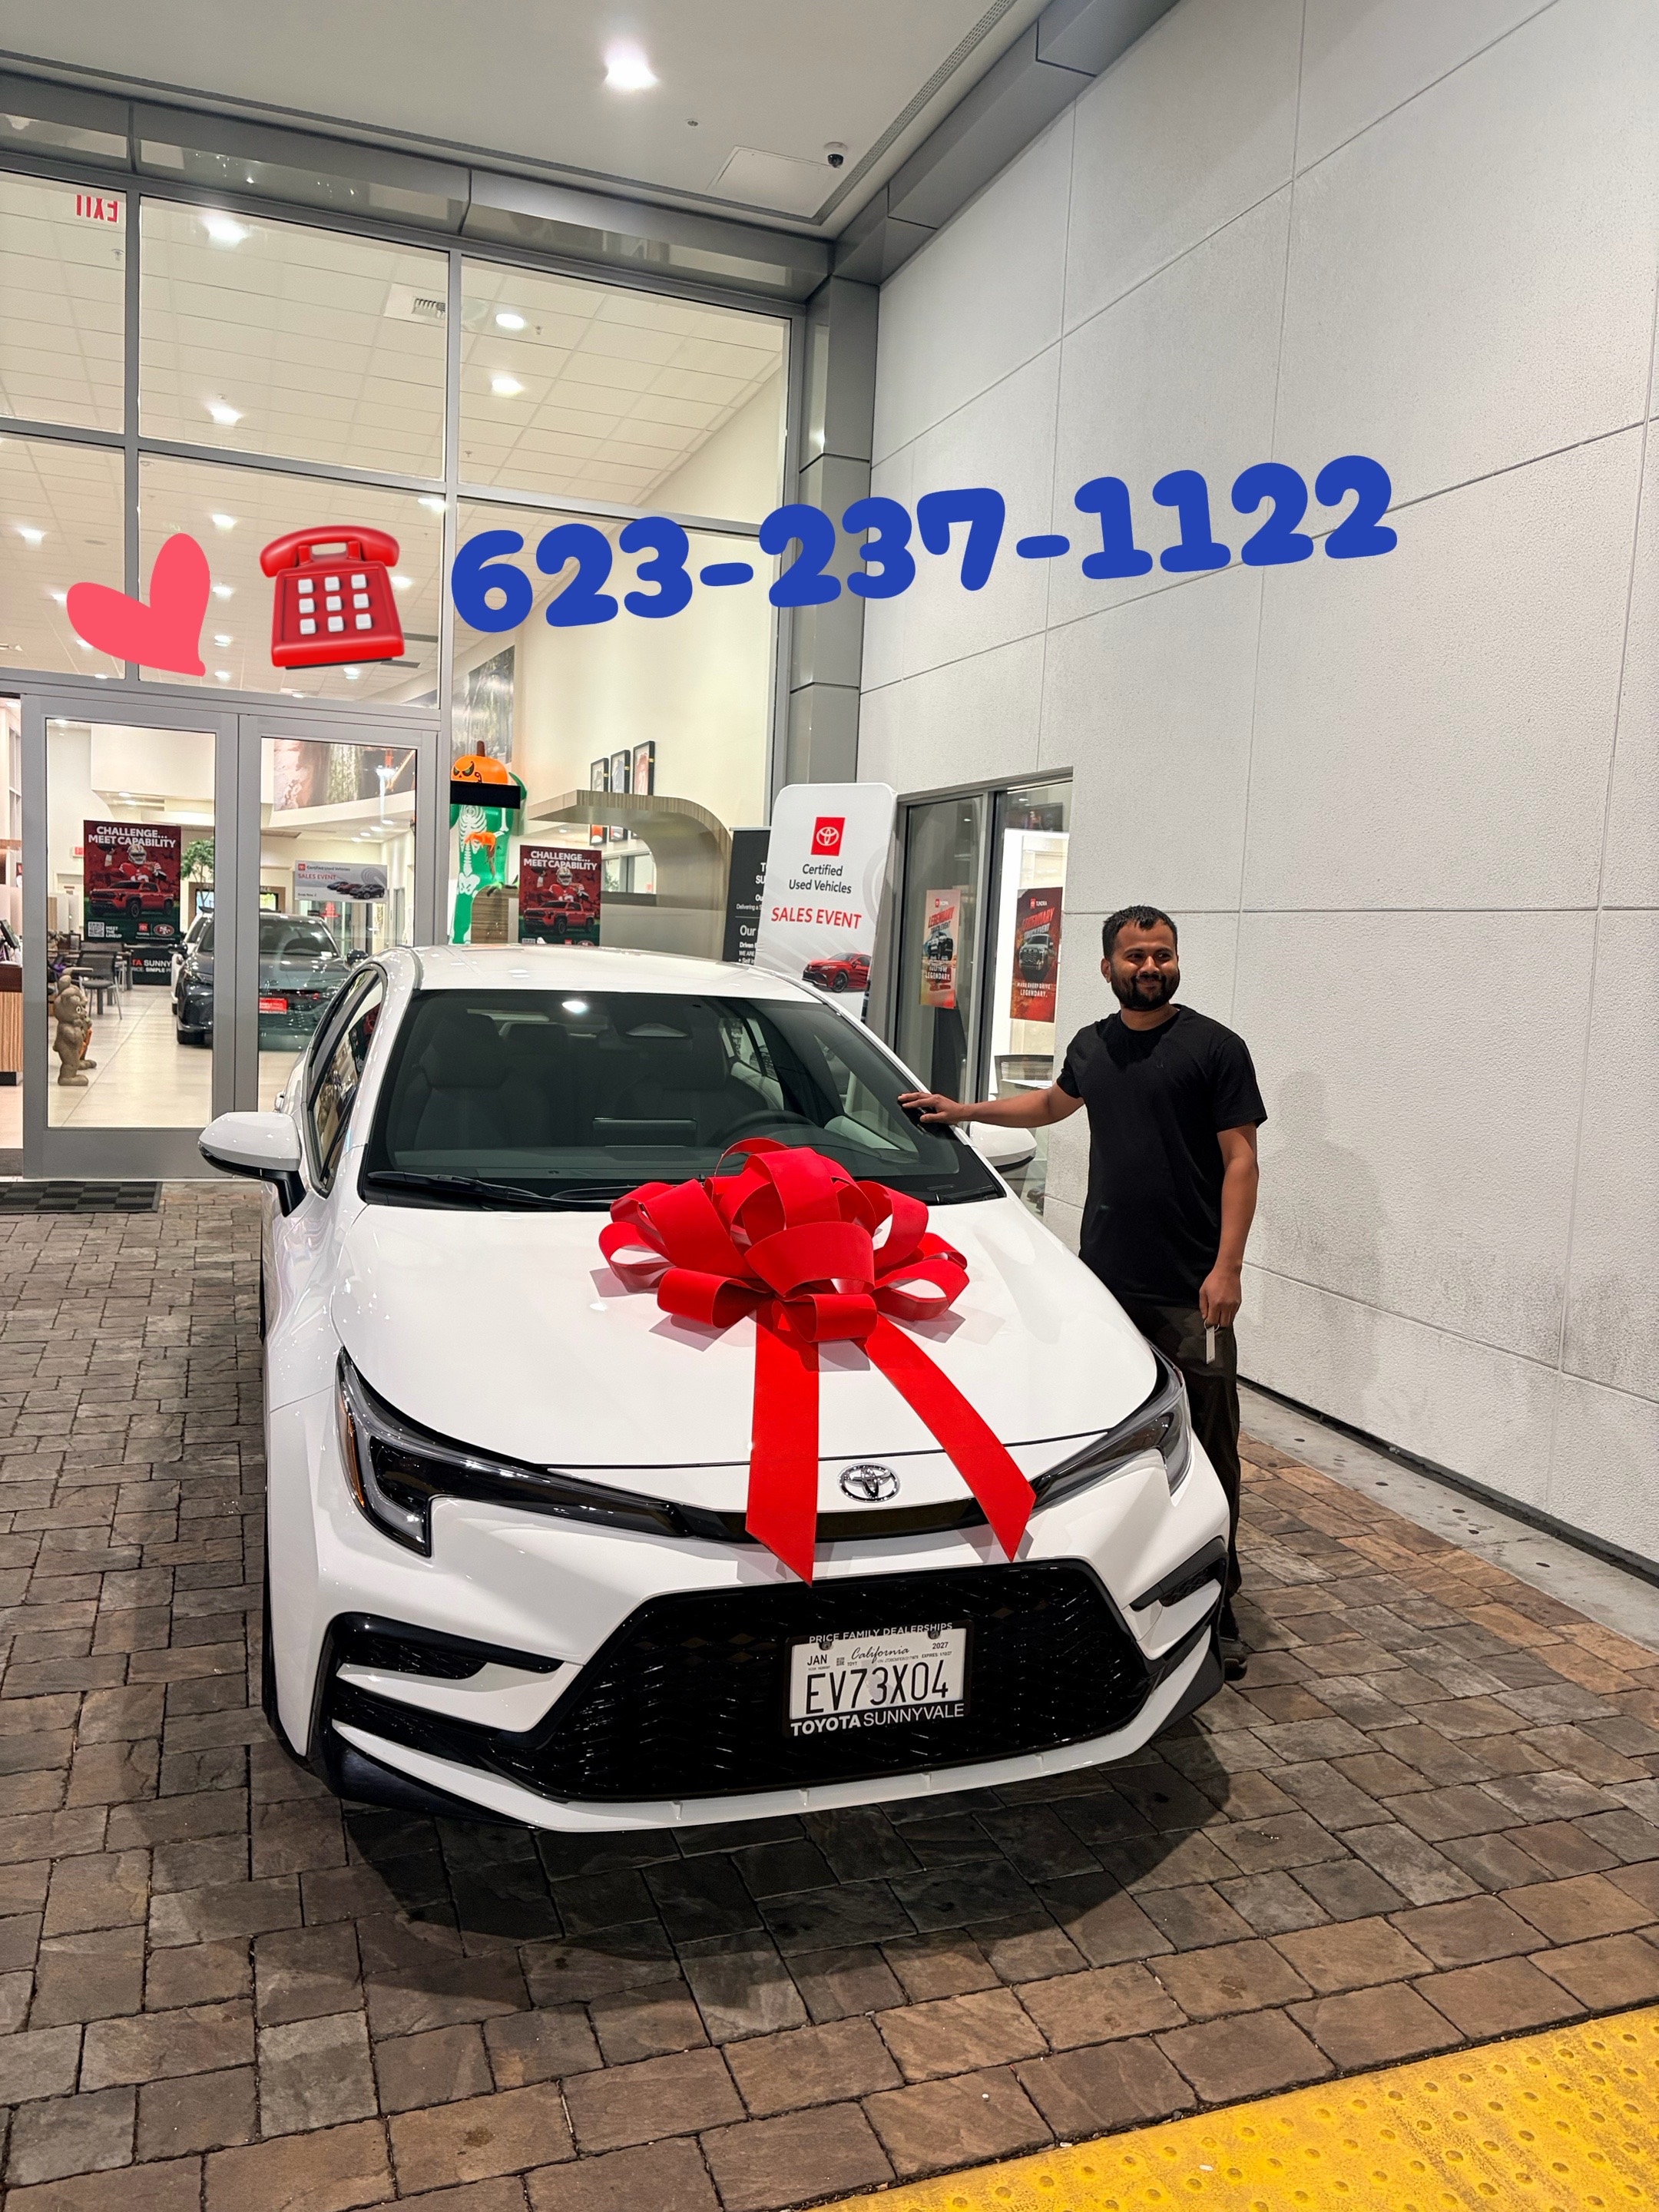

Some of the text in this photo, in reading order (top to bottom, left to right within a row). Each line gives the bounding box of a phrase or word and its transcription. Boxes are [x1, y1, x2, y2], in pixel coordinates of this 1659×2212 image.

[96, 826, 168, 839] CHALLENGE...
[88, 834, 176, 848] MEET CAPABILITY
[530, 850, 591, 862] CHALLENGE...
[523, 859, 598, 871] MEET CAPABILITY
[802, 863, 843, 876] Certified
[789, 879, 852, 894] Used Vehicles
[771, 907, 863, 929] SALES EVENT
[740, 925, 757, 936] Our
[1020, 989, 1048, 998] LEGENDARY.
[809, 1622, 952, 1644] PRICE FAMILY DEALERSHIPS
[932, 1641, 949, 1650] 2027
[807, 1654, 827, 1666] JAN
[851, 1645, 909, 1664] California
[806, 1659, 949, 1715] EV73X04
[790, 1704, 965, 1737] TOYOTA SUNNYVALE
